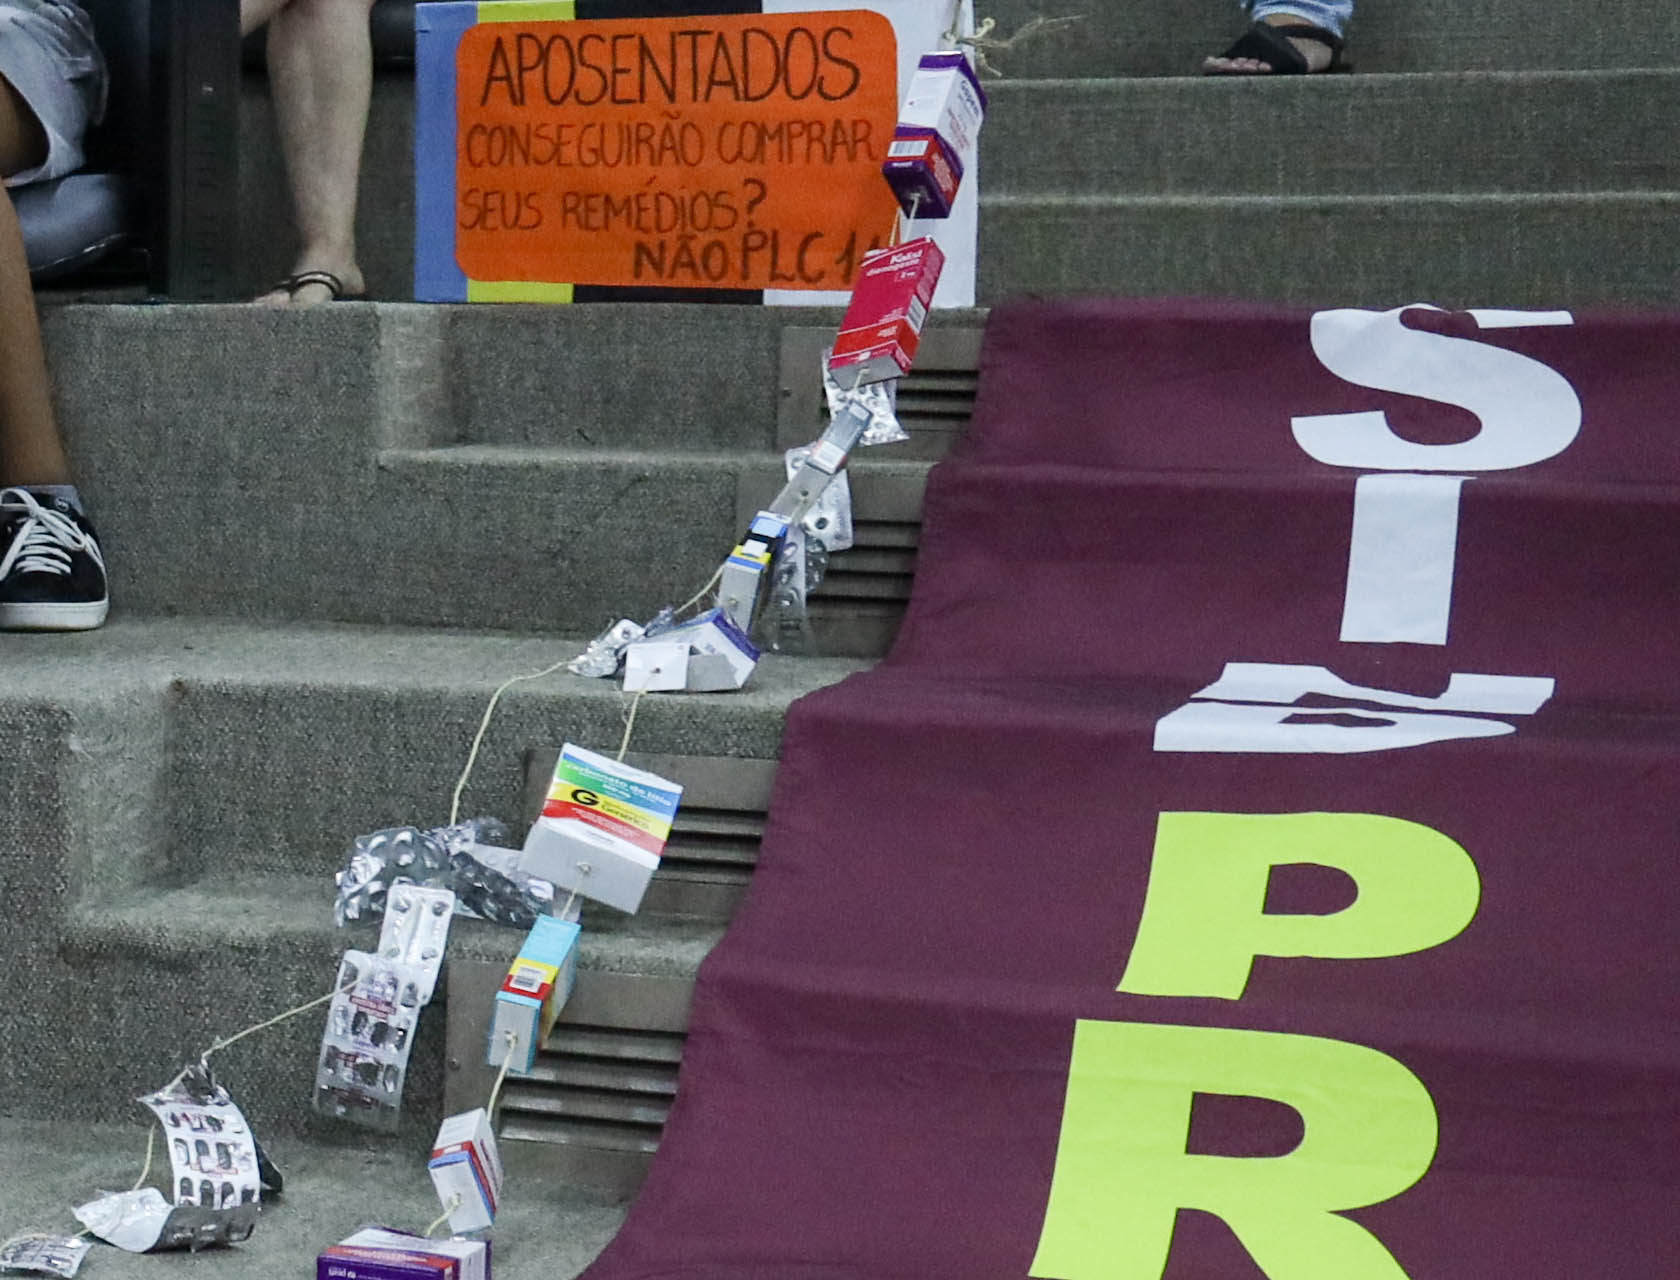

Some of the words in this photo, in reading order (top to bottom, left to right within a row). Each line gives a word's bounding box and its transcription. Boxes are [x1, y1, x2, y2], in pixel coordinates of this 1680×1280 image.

[481, 25, 861, 108] APOSENTADOS
[466, 110, 707, 169] CONSEGUIRÃO
[716, 119, 877, 166] COMPRAR
[460, 189, 544, 231] SEUS
[633, 231, 728, 282] NÃO
[740, 228, 828, 283] PLC
[571, 789, 600, 806] G
